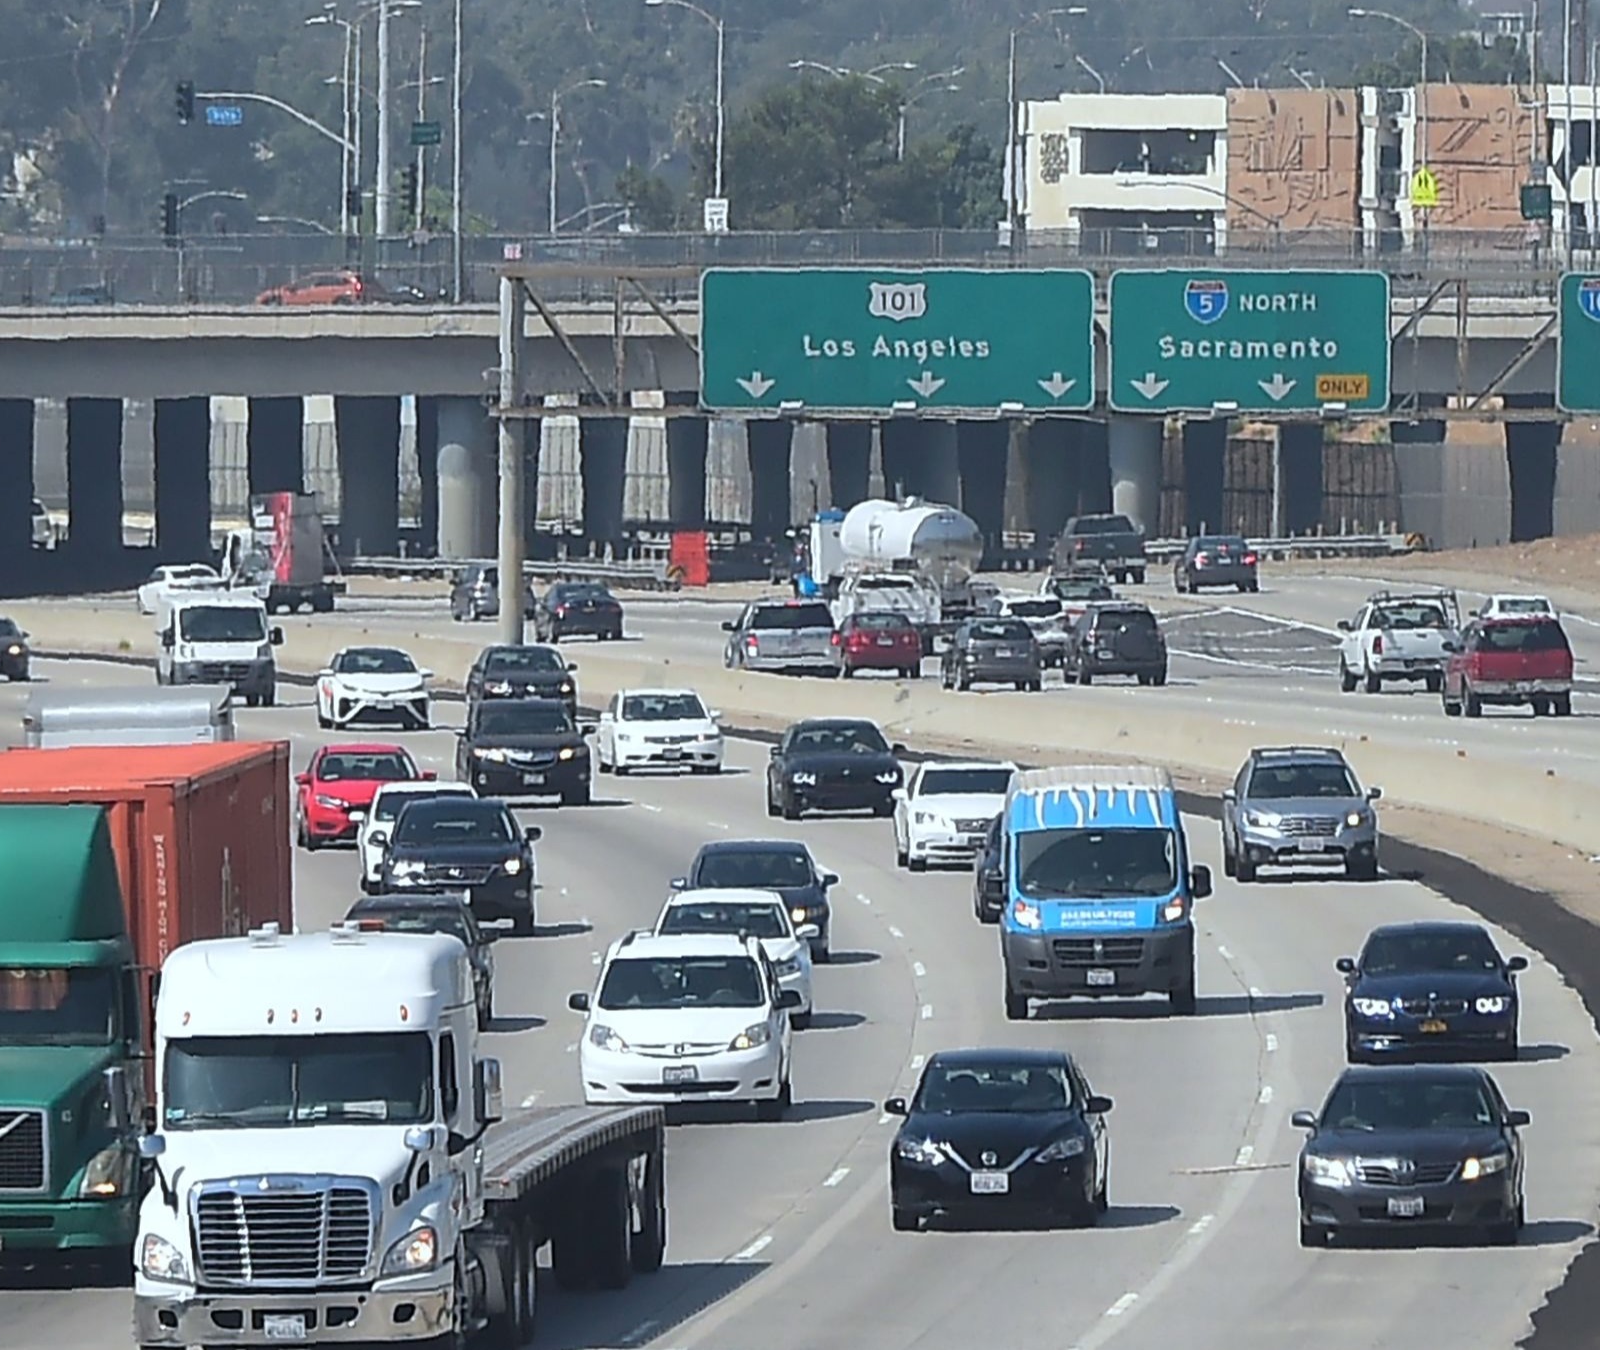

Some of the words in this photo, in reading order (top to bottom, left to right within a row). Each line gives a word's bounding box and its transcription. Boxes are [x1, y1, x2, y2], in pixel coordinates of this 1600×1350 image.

[881, 291, 917, 311] 101
[1200, 294, 1213, 314] 5
[1239, 294, 1316, 312] NORTH
[803, 335, 855, 358] Los
[872, 335, 990, 364] Angeles
[1158, 335, 1338, 359] Sacramento
[1319, 380, 1362, 395] ONLY
[153, 834, 167, 896] WARNING
[158, 900, 167, 936] HIGH
